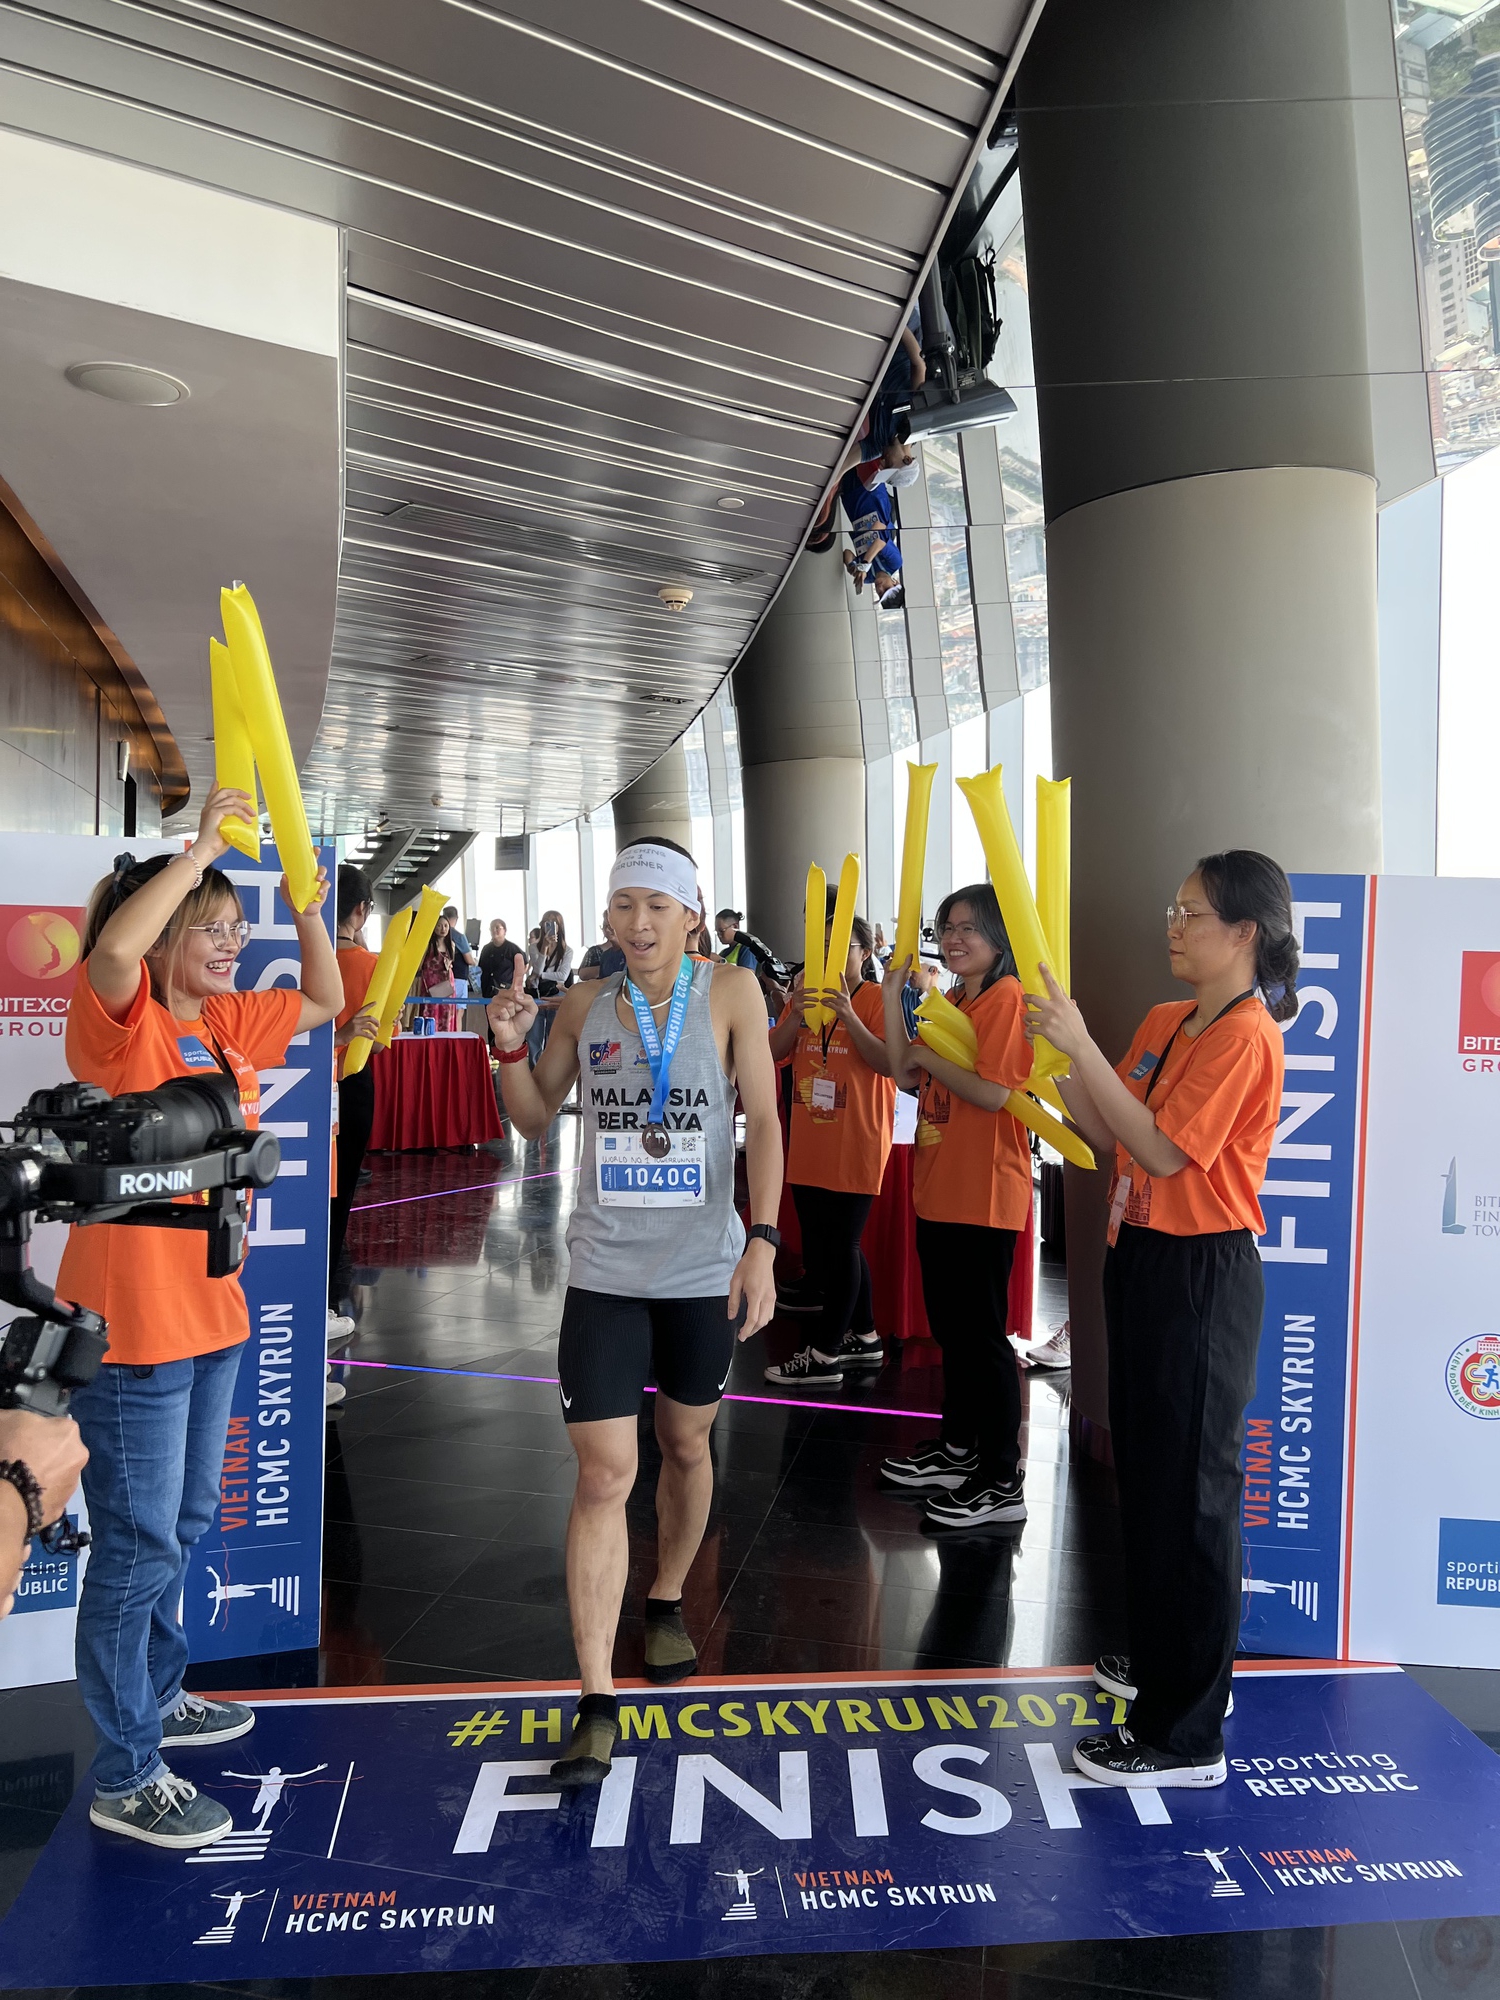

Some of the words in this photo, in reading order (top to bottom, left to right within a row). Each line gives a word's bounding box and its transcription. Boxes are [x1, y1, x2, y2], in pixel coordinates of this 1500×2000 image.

[676, 972, 690, 999] 2022
[0, 997, 71, 1013] ITEXC
[0, 1021, 64, 1037] ROU
[637, 1006, 661, 1057] FINISHER
[665, 1001, 684, 1054] FINISHER
[222, 869, 311, 1246] FNSH
[1462, 1058, 1500, 1073] GR
[590, 1088, 709, 1107] MALASIA
[119, 1168, 193, 1195] RONIN
[624, 1167, 697, 1187] 1040C
[1474, 1195, 1500, 1208] BIT
[257, 1303, 294, 1427] SKYRUN
[1280, 1314, 1316, 1434] SKYRUN
[1478, 1408, 1500, 1416] KINH
[220, 1416, 250, 1532] VIETNAM
[255, 1438, 291, 1527] HCMC
[1243, 1418, 1273, 1528] VIETNAM
[1276, 1444, 1312, 1530] HCMC
[1446, 1561, 1500, 1575] sporti
[17, 1577, 68, 1597] UBLIC
[446, 1692, 1136, 1747] #HMCSKYRUN2022
[1230, 1751, 1398, 1775] sporting
[452, 1743, 1173, 1854] FINISH
[1244, 1773, 1419, 1797] REPUBLIC
[1259, 1847, 1358, 1866] VIETNAM
[793, 1868, 894, 1888] VIETNAM
[1273, 1865, 1354, 1887] HCMC
[1355, 1859, 1464, 1882] SKYRUN
[293, 1890, 397, 1910] VIETNAM
[799, 1887, 879, 1910] HCMC
[886, 1883, 997, 1907] SKYRUN
[284, 1910, 370, 1934] HCMC
[379, 1904, 495, 1930] SKYRUN
